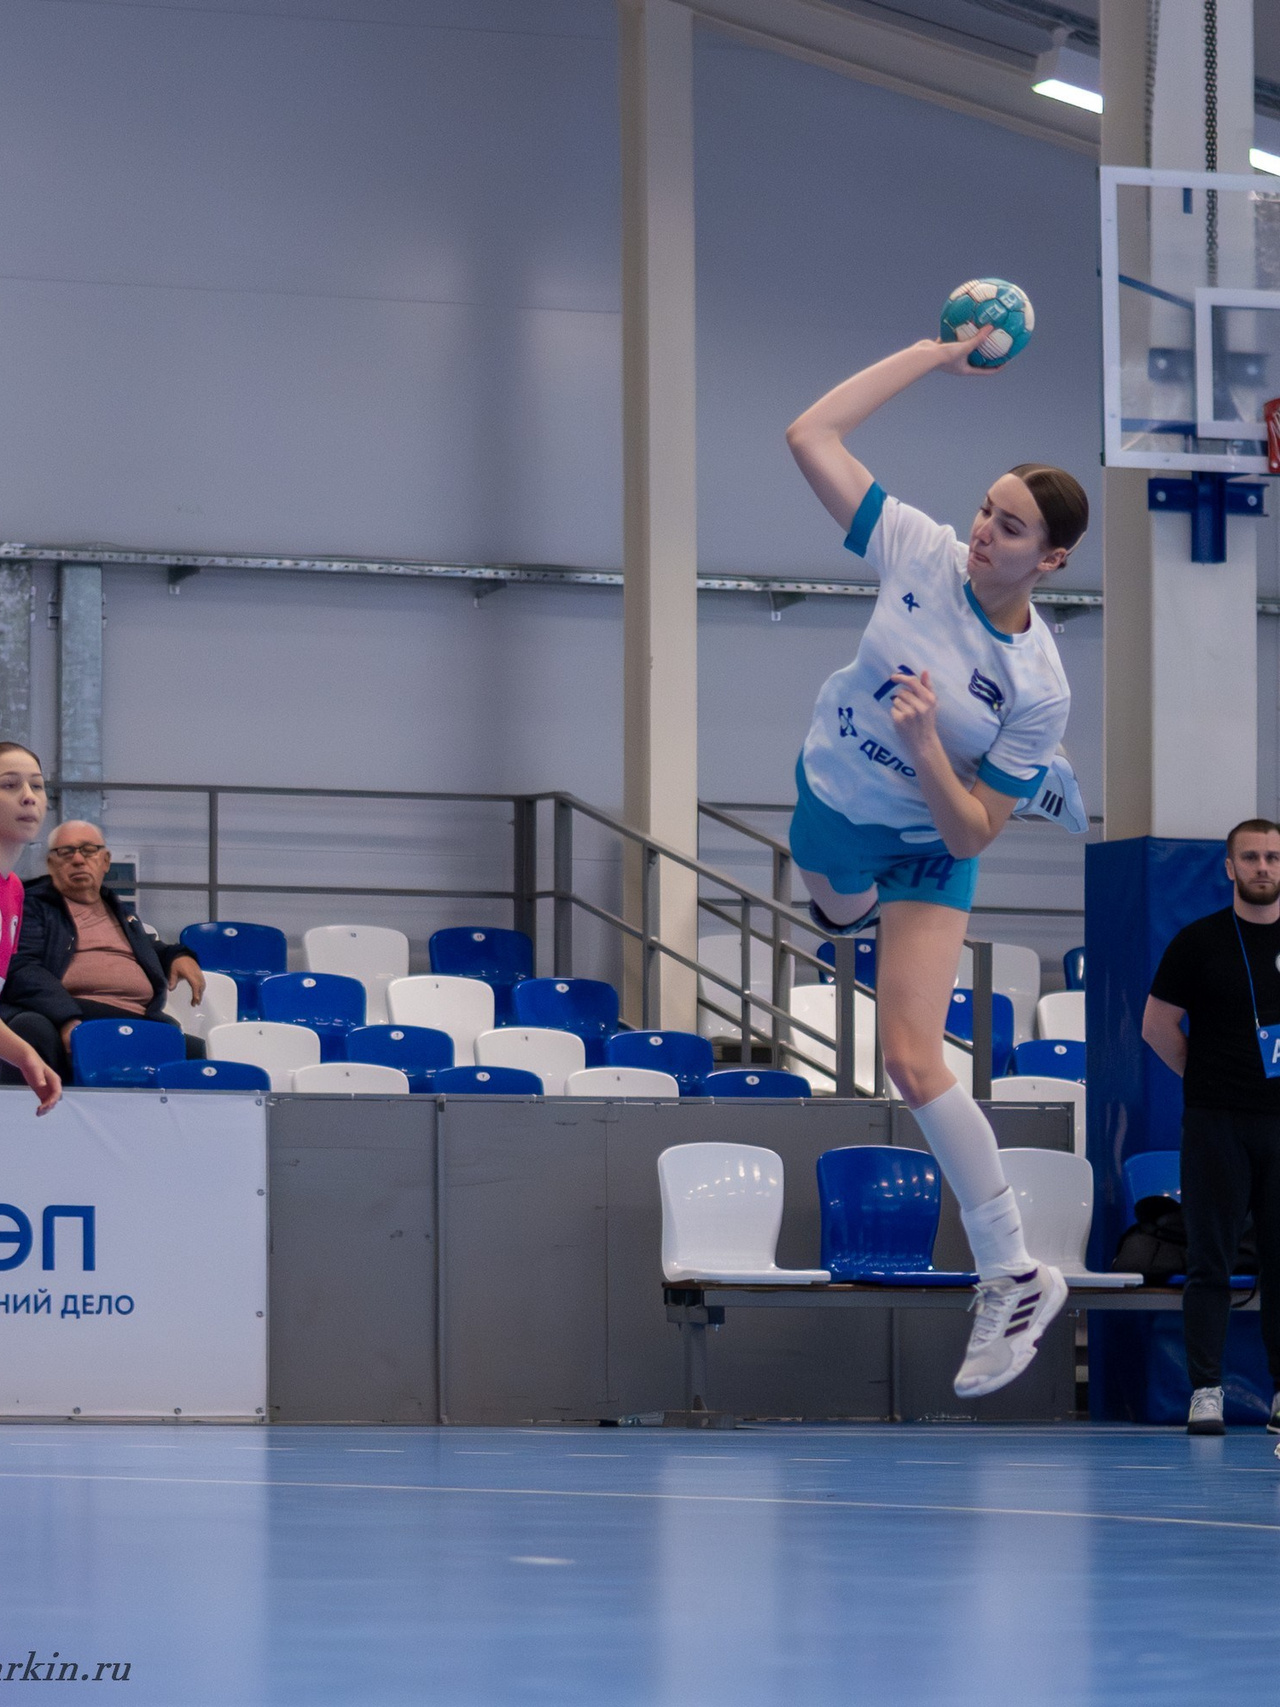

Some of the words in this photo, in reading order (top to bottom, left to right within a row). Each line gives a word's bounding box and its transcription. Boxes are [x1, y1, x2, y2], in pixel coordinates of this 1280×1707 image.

[859, 739, 917, 777] ДЕЛО
[910, 854, 955, 890] 14
[60, 1293, 136, 1319] ДЕЛО
